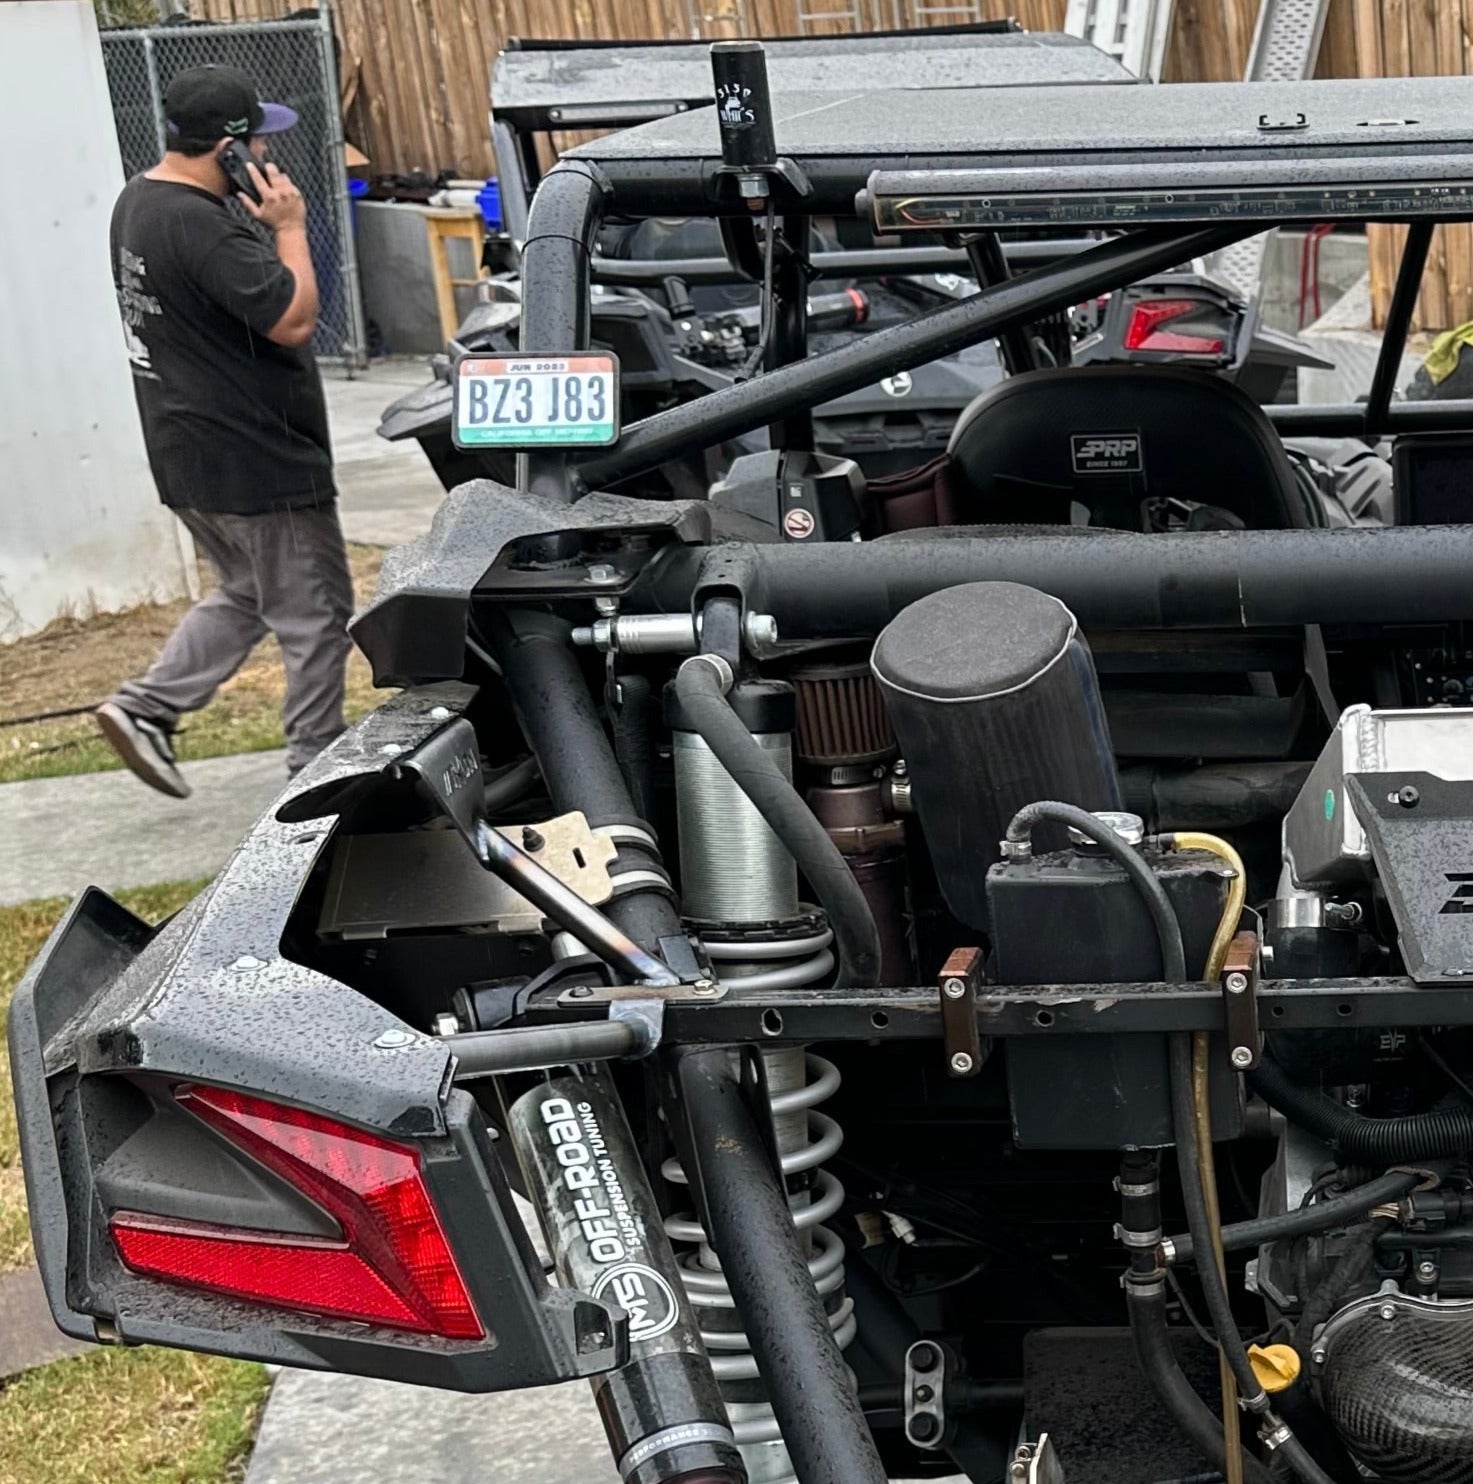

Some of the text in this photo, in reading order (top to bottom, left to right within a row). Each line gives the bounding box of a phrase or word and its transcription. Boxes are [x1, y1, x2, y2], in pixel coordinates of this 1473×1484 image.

[510, 363, 531, 371] JUN
[469, 375, 606, 424] BZ3 J83
[1076, 440, 1137, 457] PRP
[577, 1101, 642, 1248] SUSPENSION TUNING
